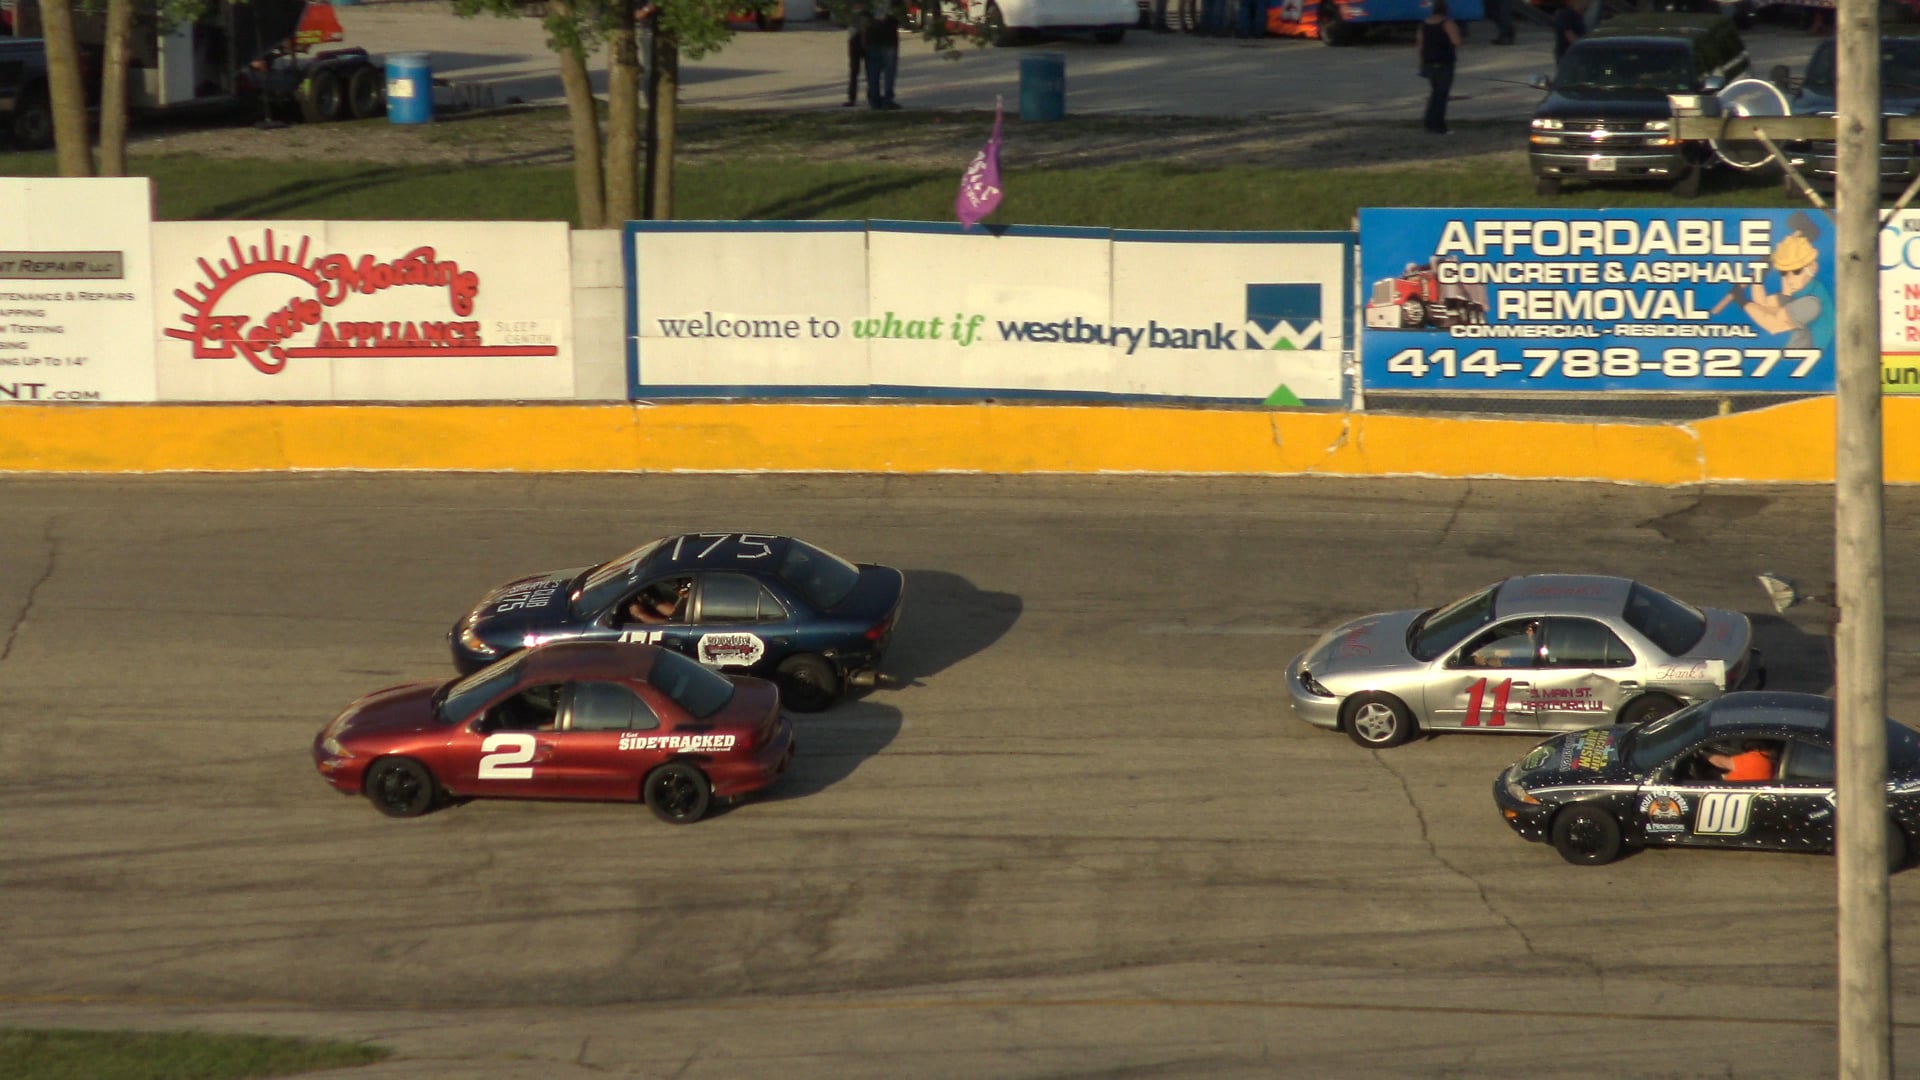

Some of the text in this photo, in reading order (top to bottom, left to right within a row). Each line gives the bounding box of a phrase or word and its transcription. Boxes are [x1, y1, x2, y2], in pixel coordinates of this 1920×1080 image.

[1435, 219, 1772, 256] AFFORDABLE
[1438, 261, 1770, 284] CONCRETE & ASPHALT
[66, 293, 76, 301] &
[79, 292, 136, 301] REPAIRS
[1497, 290, 1710, 320] REMOVAL
[193, 246, 479, 375] Kettle Moraine
[10, 324, 65, 334] TESTING
[316, 321, 482, 348] APPLIANCE
[495, 321, 538, 332] SLEEP
[658, 311, 800, 340] welcome
[807, 315, 841, 340] to
[852, 311, 944, 340] what
[996, 316, 1146, 355] westbury
[1148, 320, 1238, 350] bank
[1450, 324, 1600, 339] COMMERCIAL
[1614, 323, 1758, 338] RESIDENTIAL
[22, 357, 42, 366] UP
[44, 357, 62, 366] TO
[1387, 348, 1822, 378] 414-788-8277
[672, 532, 778, 560] 175
[1461, 677, 1512, 727] 11
[1542, 687, 1573, 698] MAIN
[1575, 686, 1593, 698] ST.
[478, 732, 537, 779] 2
[618, 735, 736, 751] SIDETRACKED
[1697, 793, 1752, 833] 00
